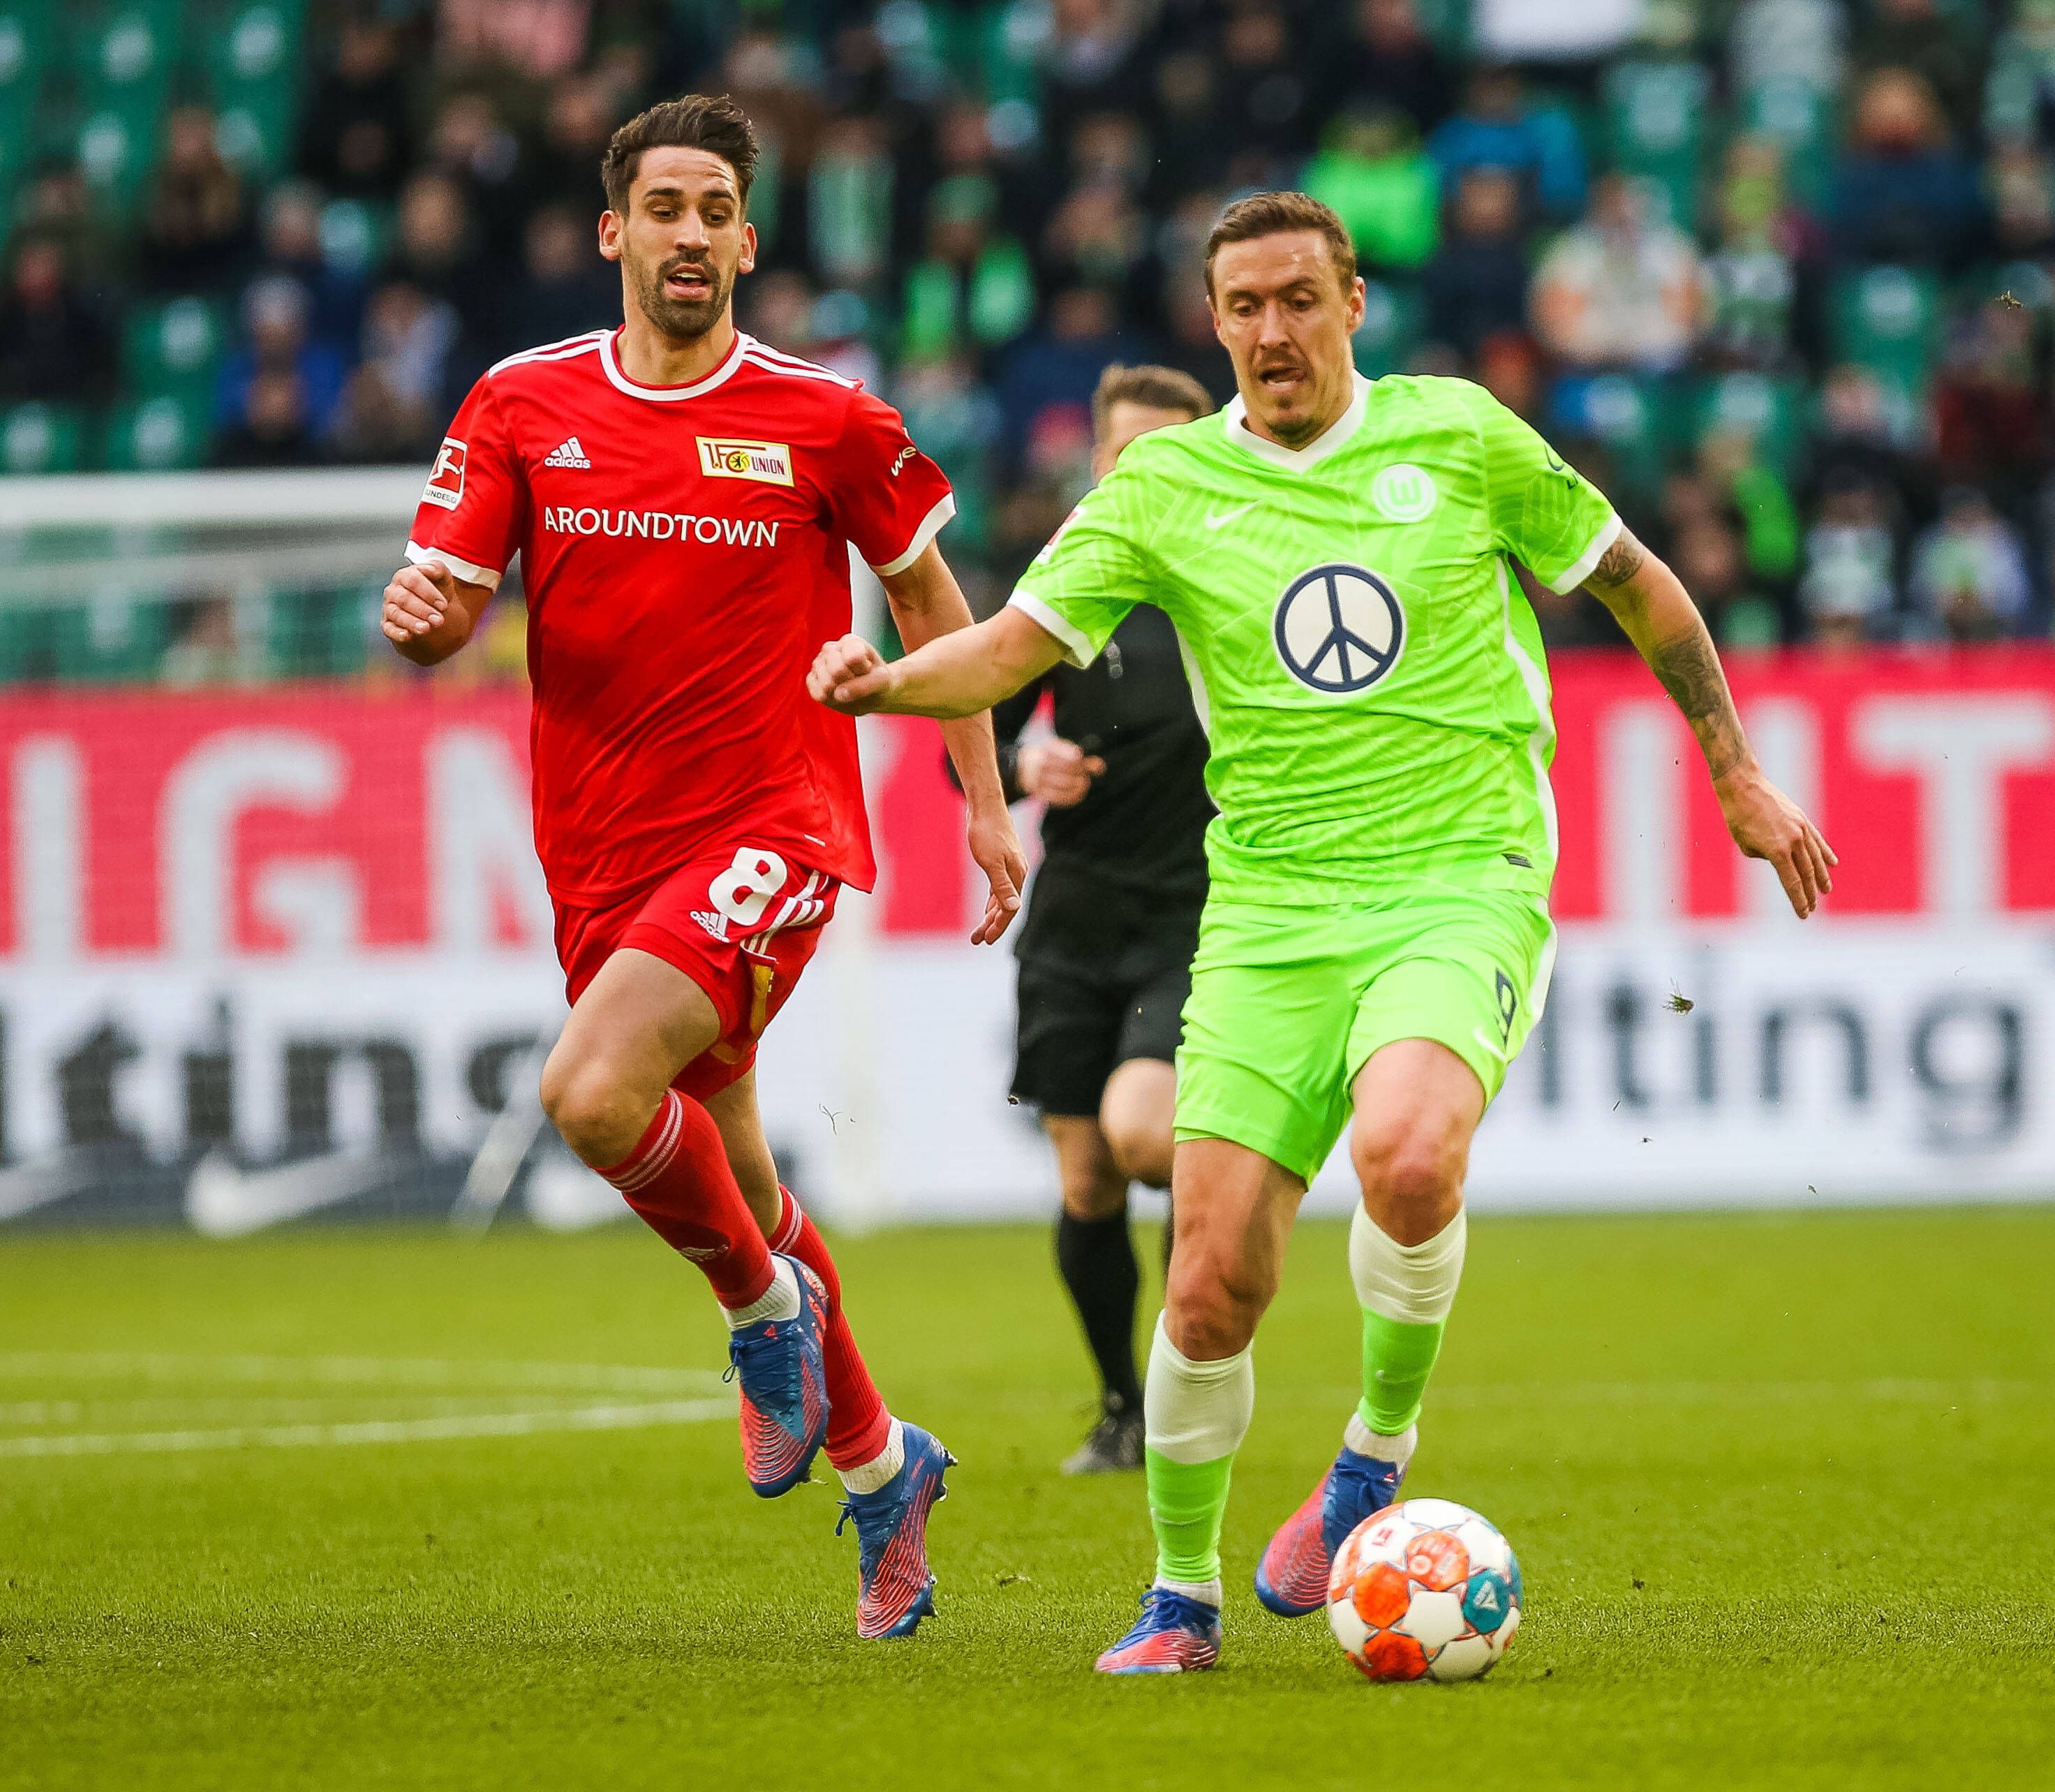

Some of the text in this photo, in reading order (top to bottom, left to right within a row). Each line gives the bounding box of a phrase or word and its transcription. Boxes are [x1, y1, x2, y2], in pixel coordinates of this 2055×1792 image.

[544, 456, 592, 470] adidas
[751, 456, 785, 475] UNION
[544, 506, 779, 547] AROUNDTOWN
[707, 846, 788, 926] 8
